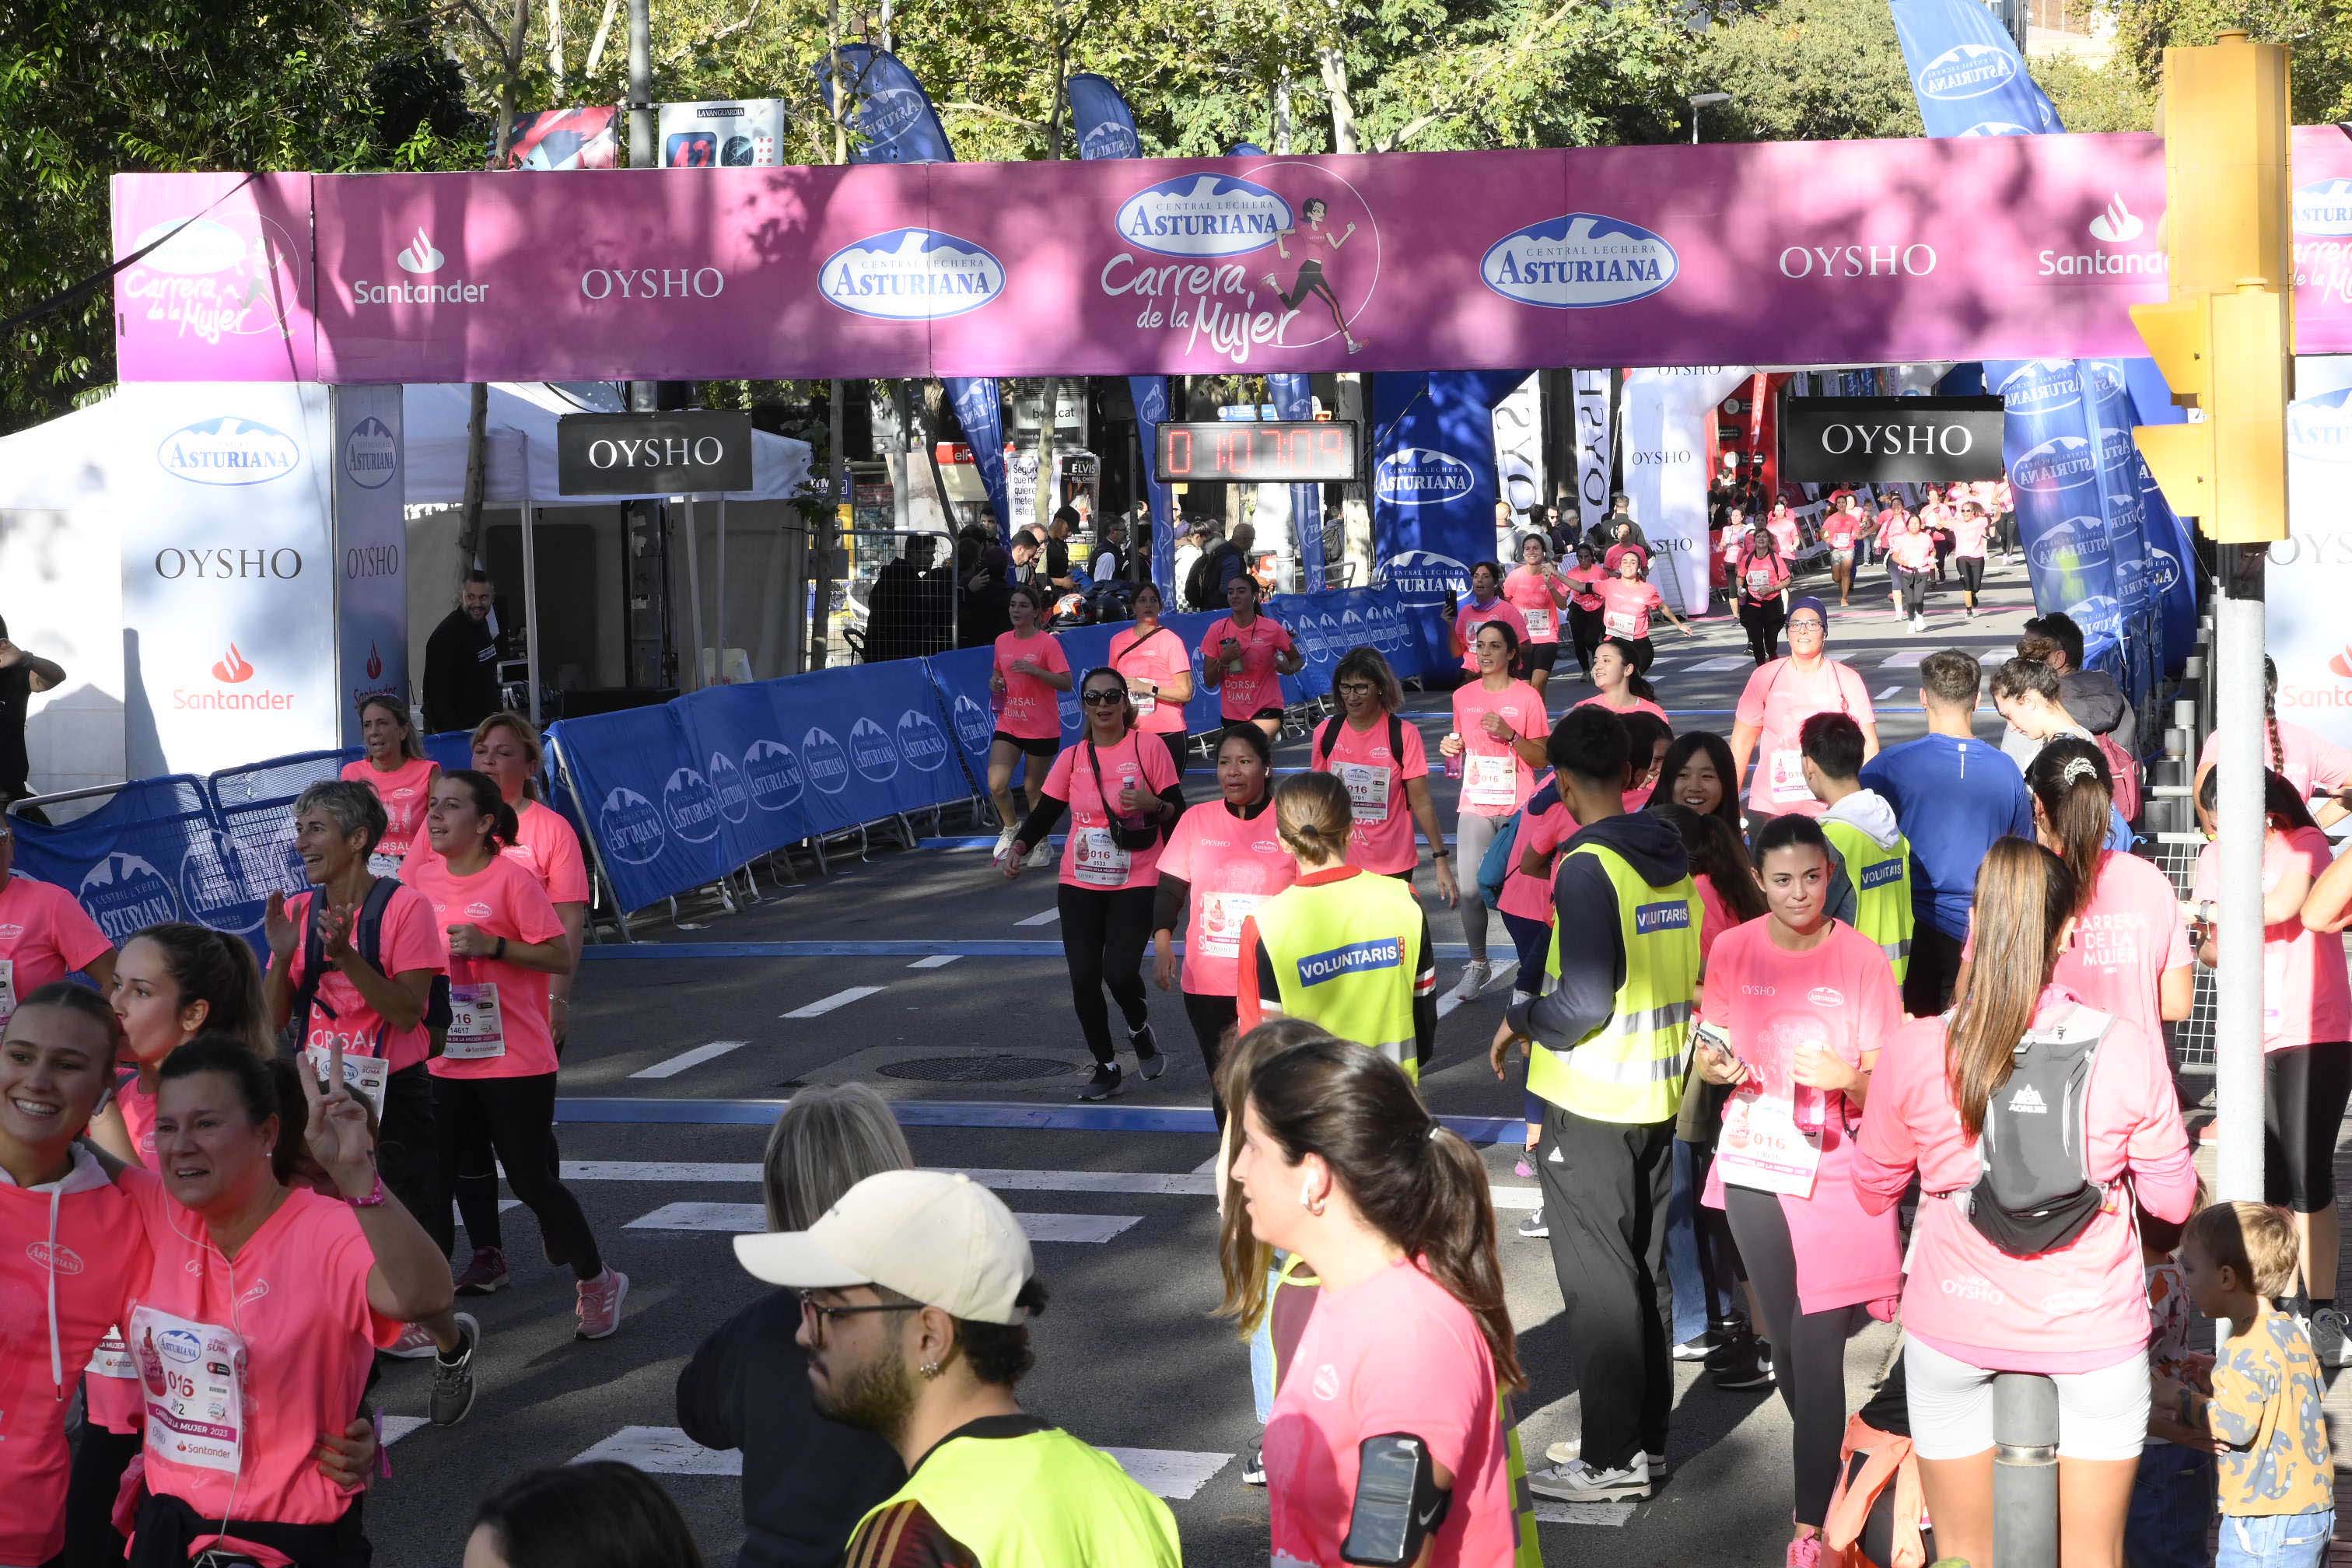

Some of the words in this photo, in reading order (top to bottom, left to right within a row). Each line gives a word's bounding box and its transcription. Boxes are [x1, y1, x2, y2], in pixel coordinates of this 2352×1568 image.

[1157, 202, 1212, 211] CENTRAL
[1217, 201, 1275, 210] LECHERA
[1130, 205, 1279, 237] ASTURIANA
[1526, 246, 1587, 257] CENTRAL
[1594, 245, 1656, 255] LECHERA
[1780, 243, 1936, 279] OYSHO
[1101, 253, 1246, 297] Carrera
[1496, 250, 1663, 285] ASTURIANA
[124, 269, 216, 299] Carrera
[354, 279, 490, 305] Santander
[582, 268, 724, 300] OYSHO
[833, 266, 991, 298] ASTURIANA
[180, 294, 252, 345] Mujer
[1136, 299, 1164, 328] de
[1170, 298, 1189, 328] la
[1185, 291, 1301, 364] Mujer
[1822, 424, 1972, 456] OYSHO
[170, 442, 289, 467] ASTURIANA
[348, 445, 394, 471] ASTURIANA
[589, 436, 723, 469] OYSHO
[1632, 450, 1691, 466] OYSHO
[1072, 464, 1097, 474] ELVIS
[1379, 470, 1467, 492] ASTURIANA
[1014, 487, 1038, 495] quiere
[156, 548, 302, 579] OYSHO
[347, 544, 398, 579] OYSHO
[1382, 574, 1467, 593] TURIANA
[174, 689, 295, 710] Santander
[807, 754, 846, 779] ASTURIANA
[853, 744, 897, 768] ASTURIANA
[747, 768, 803, 797] ASTURIANA
[1481, 775, 1499, 783] 016
[1075, 812, 1090, 824] TU
[376, 841, 411, 851] ORSAL
[1090, 850, 1111, 859] 016
[1201, 838, 1230, 848] OYSHO
[2085, 933, 2105, 949] DE
[2112, 931, 2133, 947] LA
[1301, 945, 1397, 978] VOLUNTARIS
[2083, 947, 2137, 967] MUJER
[455, 1013, 471, 1024] 16
[310, 1027, 376, 1051] ORSAL
[1753, 1132, 1787, 1150] 016
[160, 1337, 198, 1359] ASTURIANA
[168, 1370, 194, 1397] 016
[180, 1423, 208, 1434] MUJER
[210, 1427, 229, 1438] 2023
[187, 1444, 231, 1459] Santander
